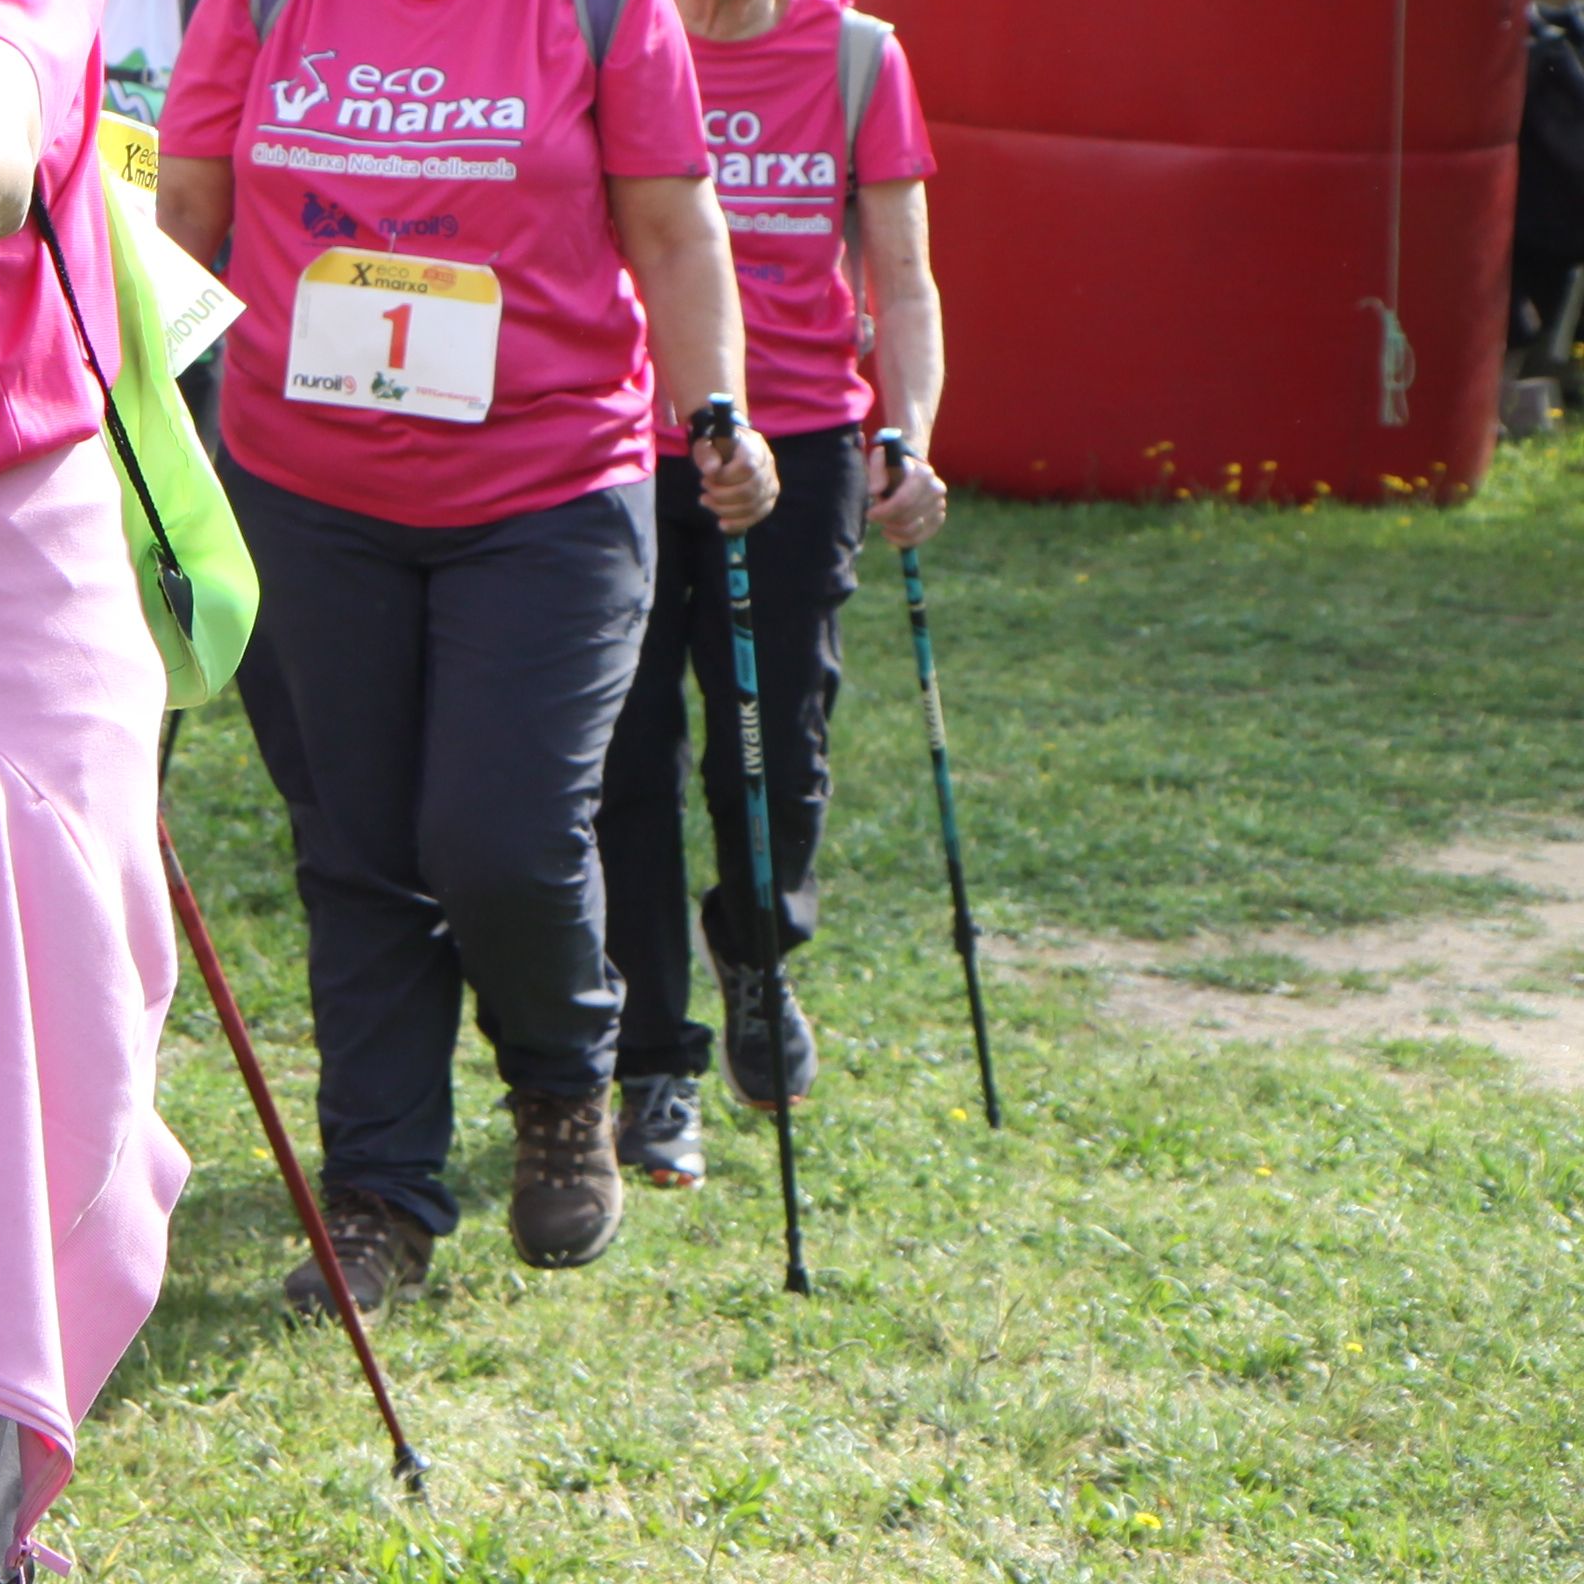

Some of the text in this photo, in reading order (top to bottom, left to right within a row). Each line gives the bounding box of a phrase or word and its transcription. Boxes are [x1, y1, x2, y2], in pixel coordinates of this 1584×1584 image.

[348, 64, 445, 97] eco
[337, 95, 526, 133] marxa
[704, 109, 761, 145] co
[252, 142, 287, 165] Club
[289, 146, 345, 172] Marxa
[424, 157, 517, 180] Collserola
[375, 277, 429, 294] marxa
[376, 266, 410, 278] eco
[382, 303, 413, 370] 1
